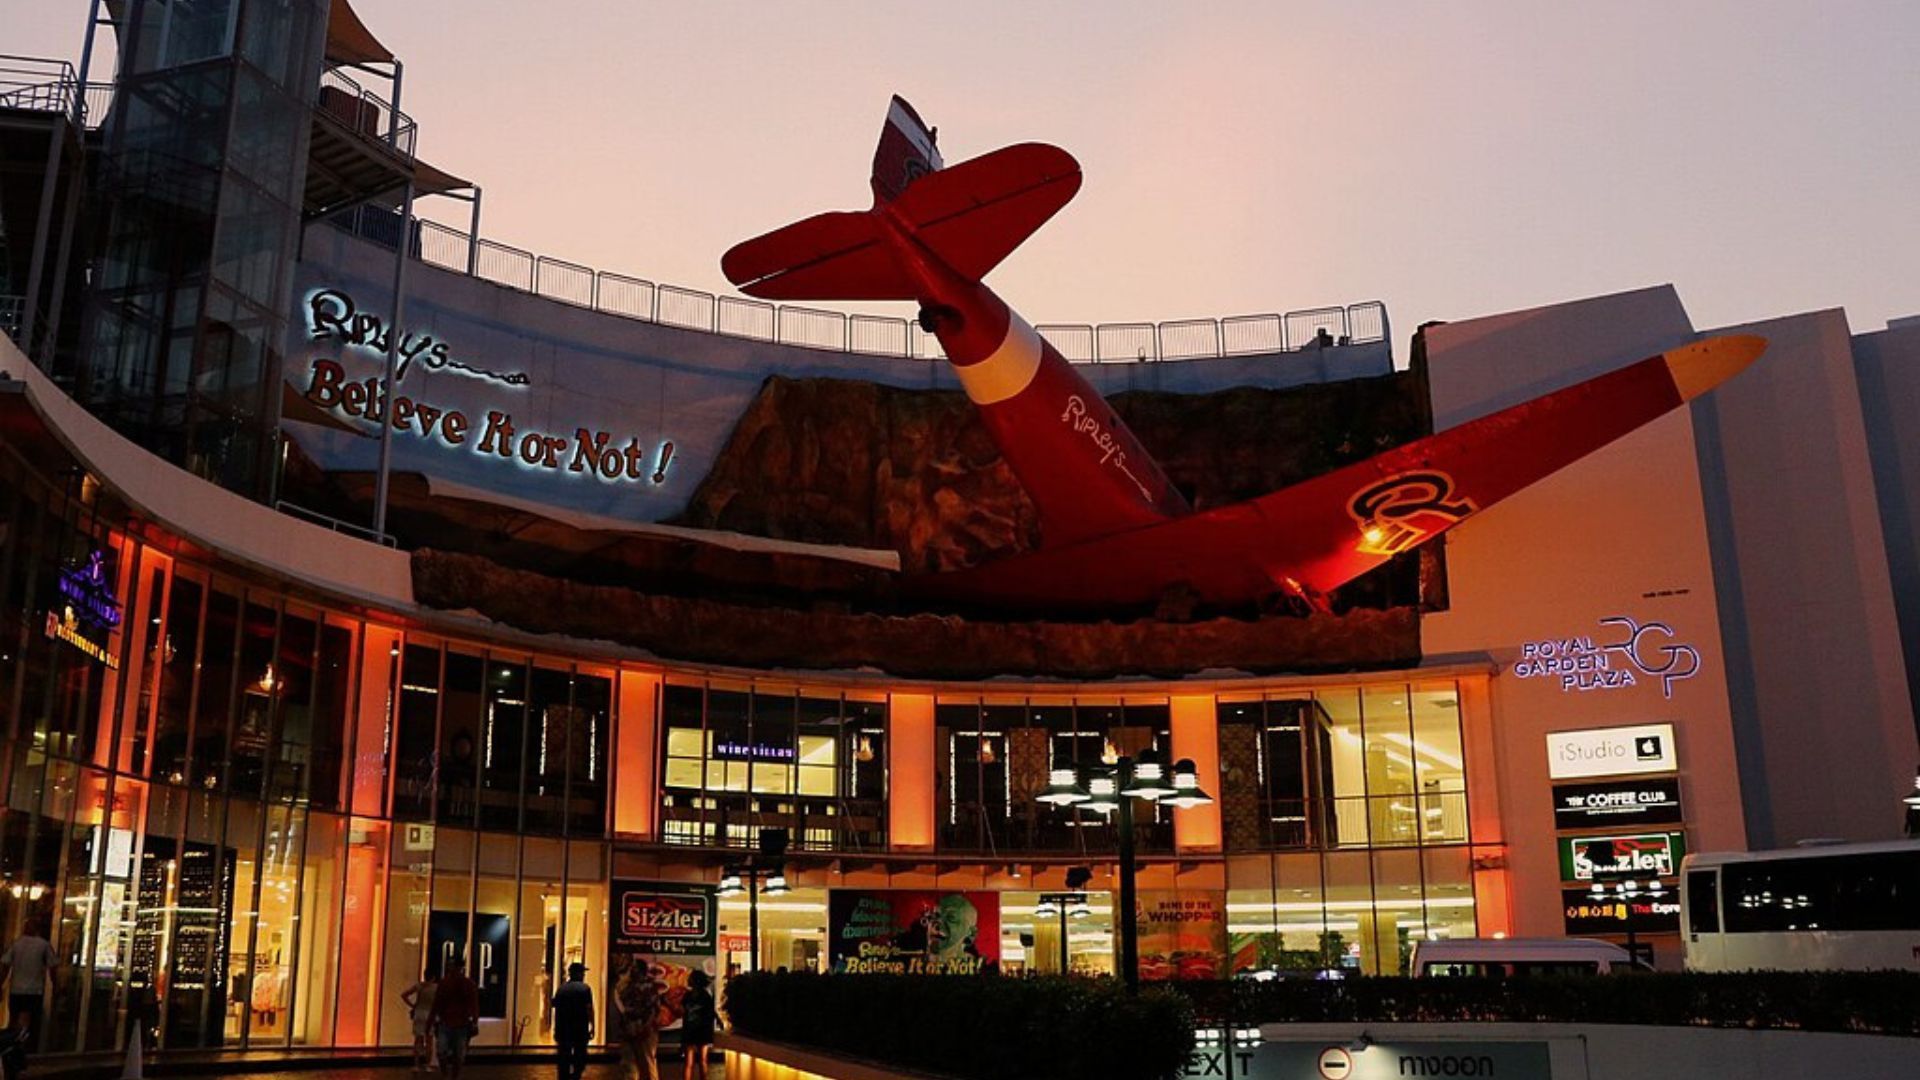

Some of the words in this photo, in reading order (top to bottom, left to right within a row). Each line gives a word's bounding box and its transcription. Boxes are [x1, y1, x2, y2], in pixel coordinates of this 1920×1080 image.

[478, 410, 515, 457] It
[520, 431, 567, 468] or
[1522, 637, 1598, 659] ROYAL
[1514, 654, 1608, 677] GARDEN
[1562, 671, 1636, 691] PLAZA
[1559, 741, 1626, 761] iStudio
[1586, 792, 1637, 806] COFFEE
[1638, 791, 1667, 802] CLUB
[1574, 849, 1670, 872] Szler
[626, 906, 703, 929] Sizzler
[441, 939, 493, 989] GP
[845, 957, 905, 975] Believe
[908, 957, 923, 974] It
[925, 961, 945, 974] or
[1184, 1052, 1254, 1076] EXT
